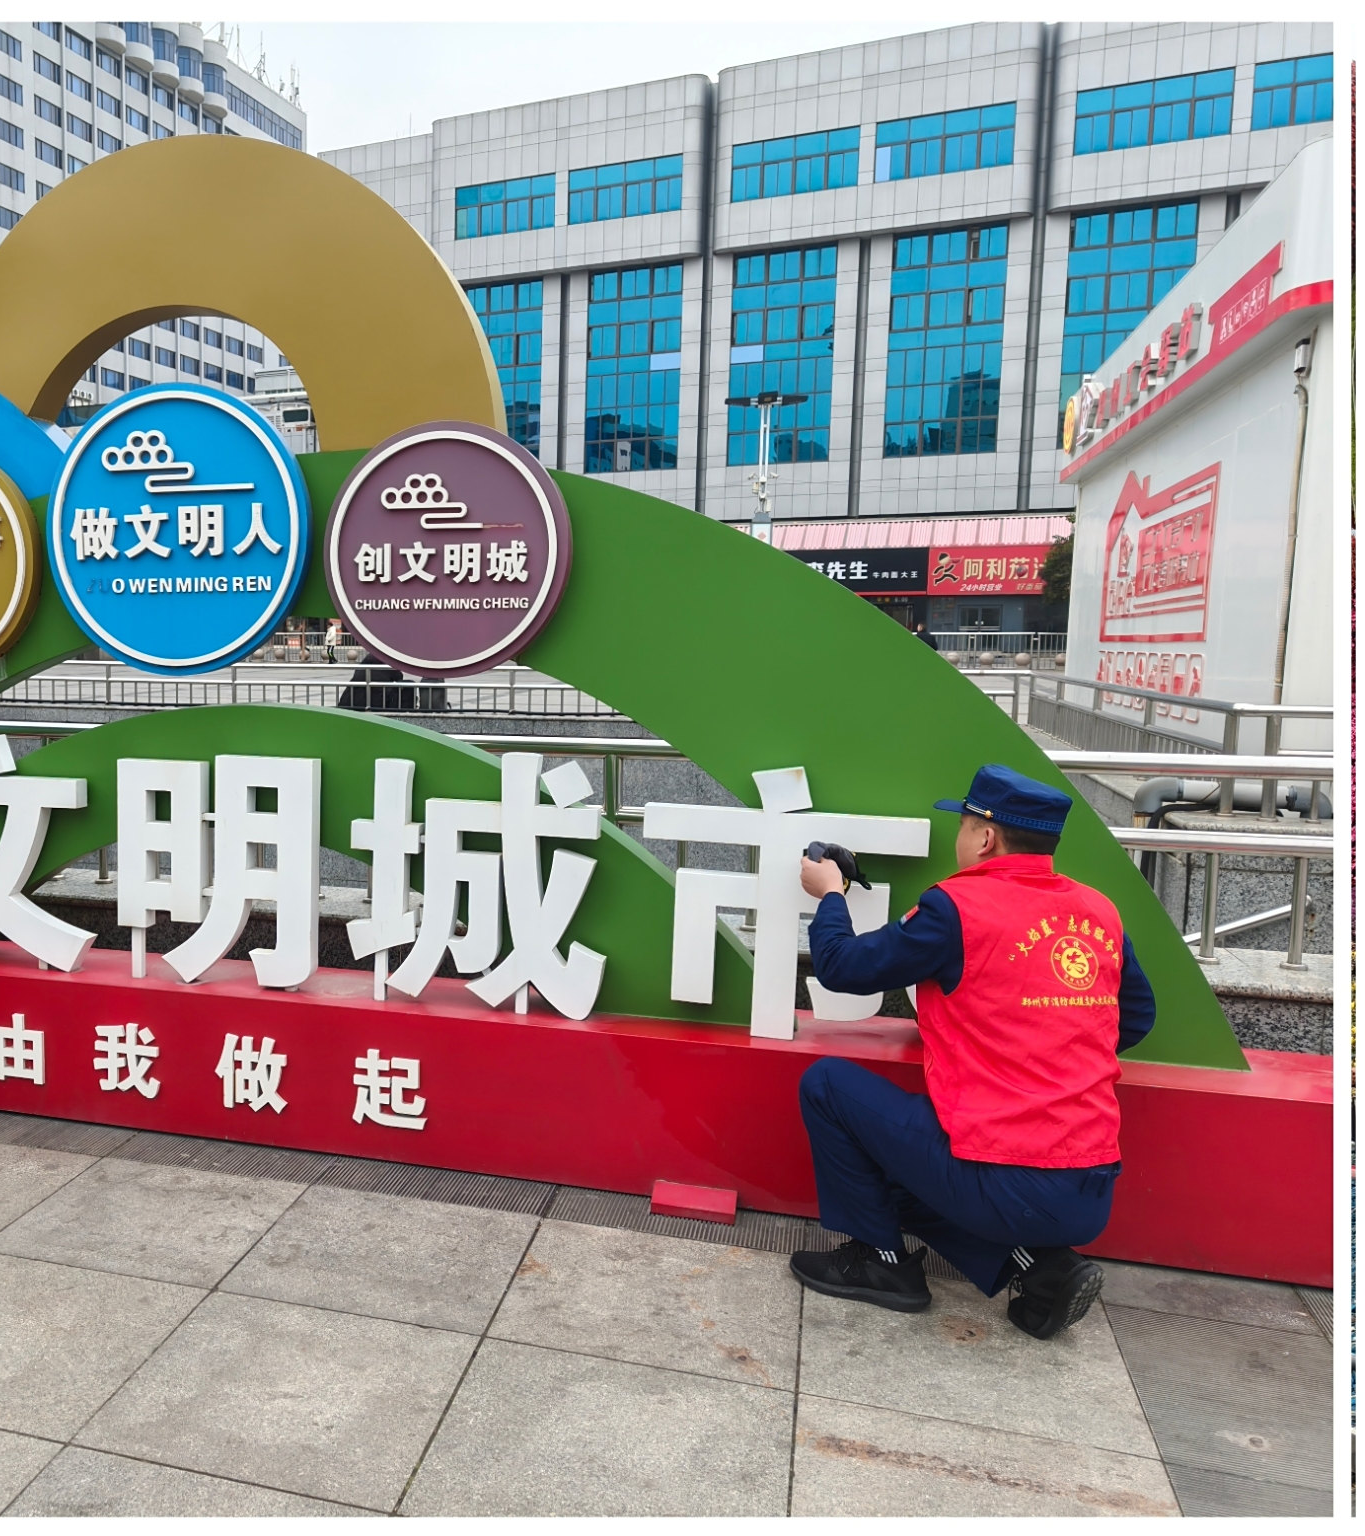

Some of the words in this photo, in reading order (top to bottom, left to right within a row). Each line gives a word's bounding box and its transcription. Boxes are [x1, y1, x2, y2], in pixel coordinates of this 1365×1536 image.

[70, 502, 285, 561] 做文明人
[353, 541, 530, 586] 创文明城
[232, 575, 273, 592] REN
[959, 583, 1003, 592] 24小时营业
[354, 598, 410, 612] CHUANG
[483, 596, 530, 610] CHENG
